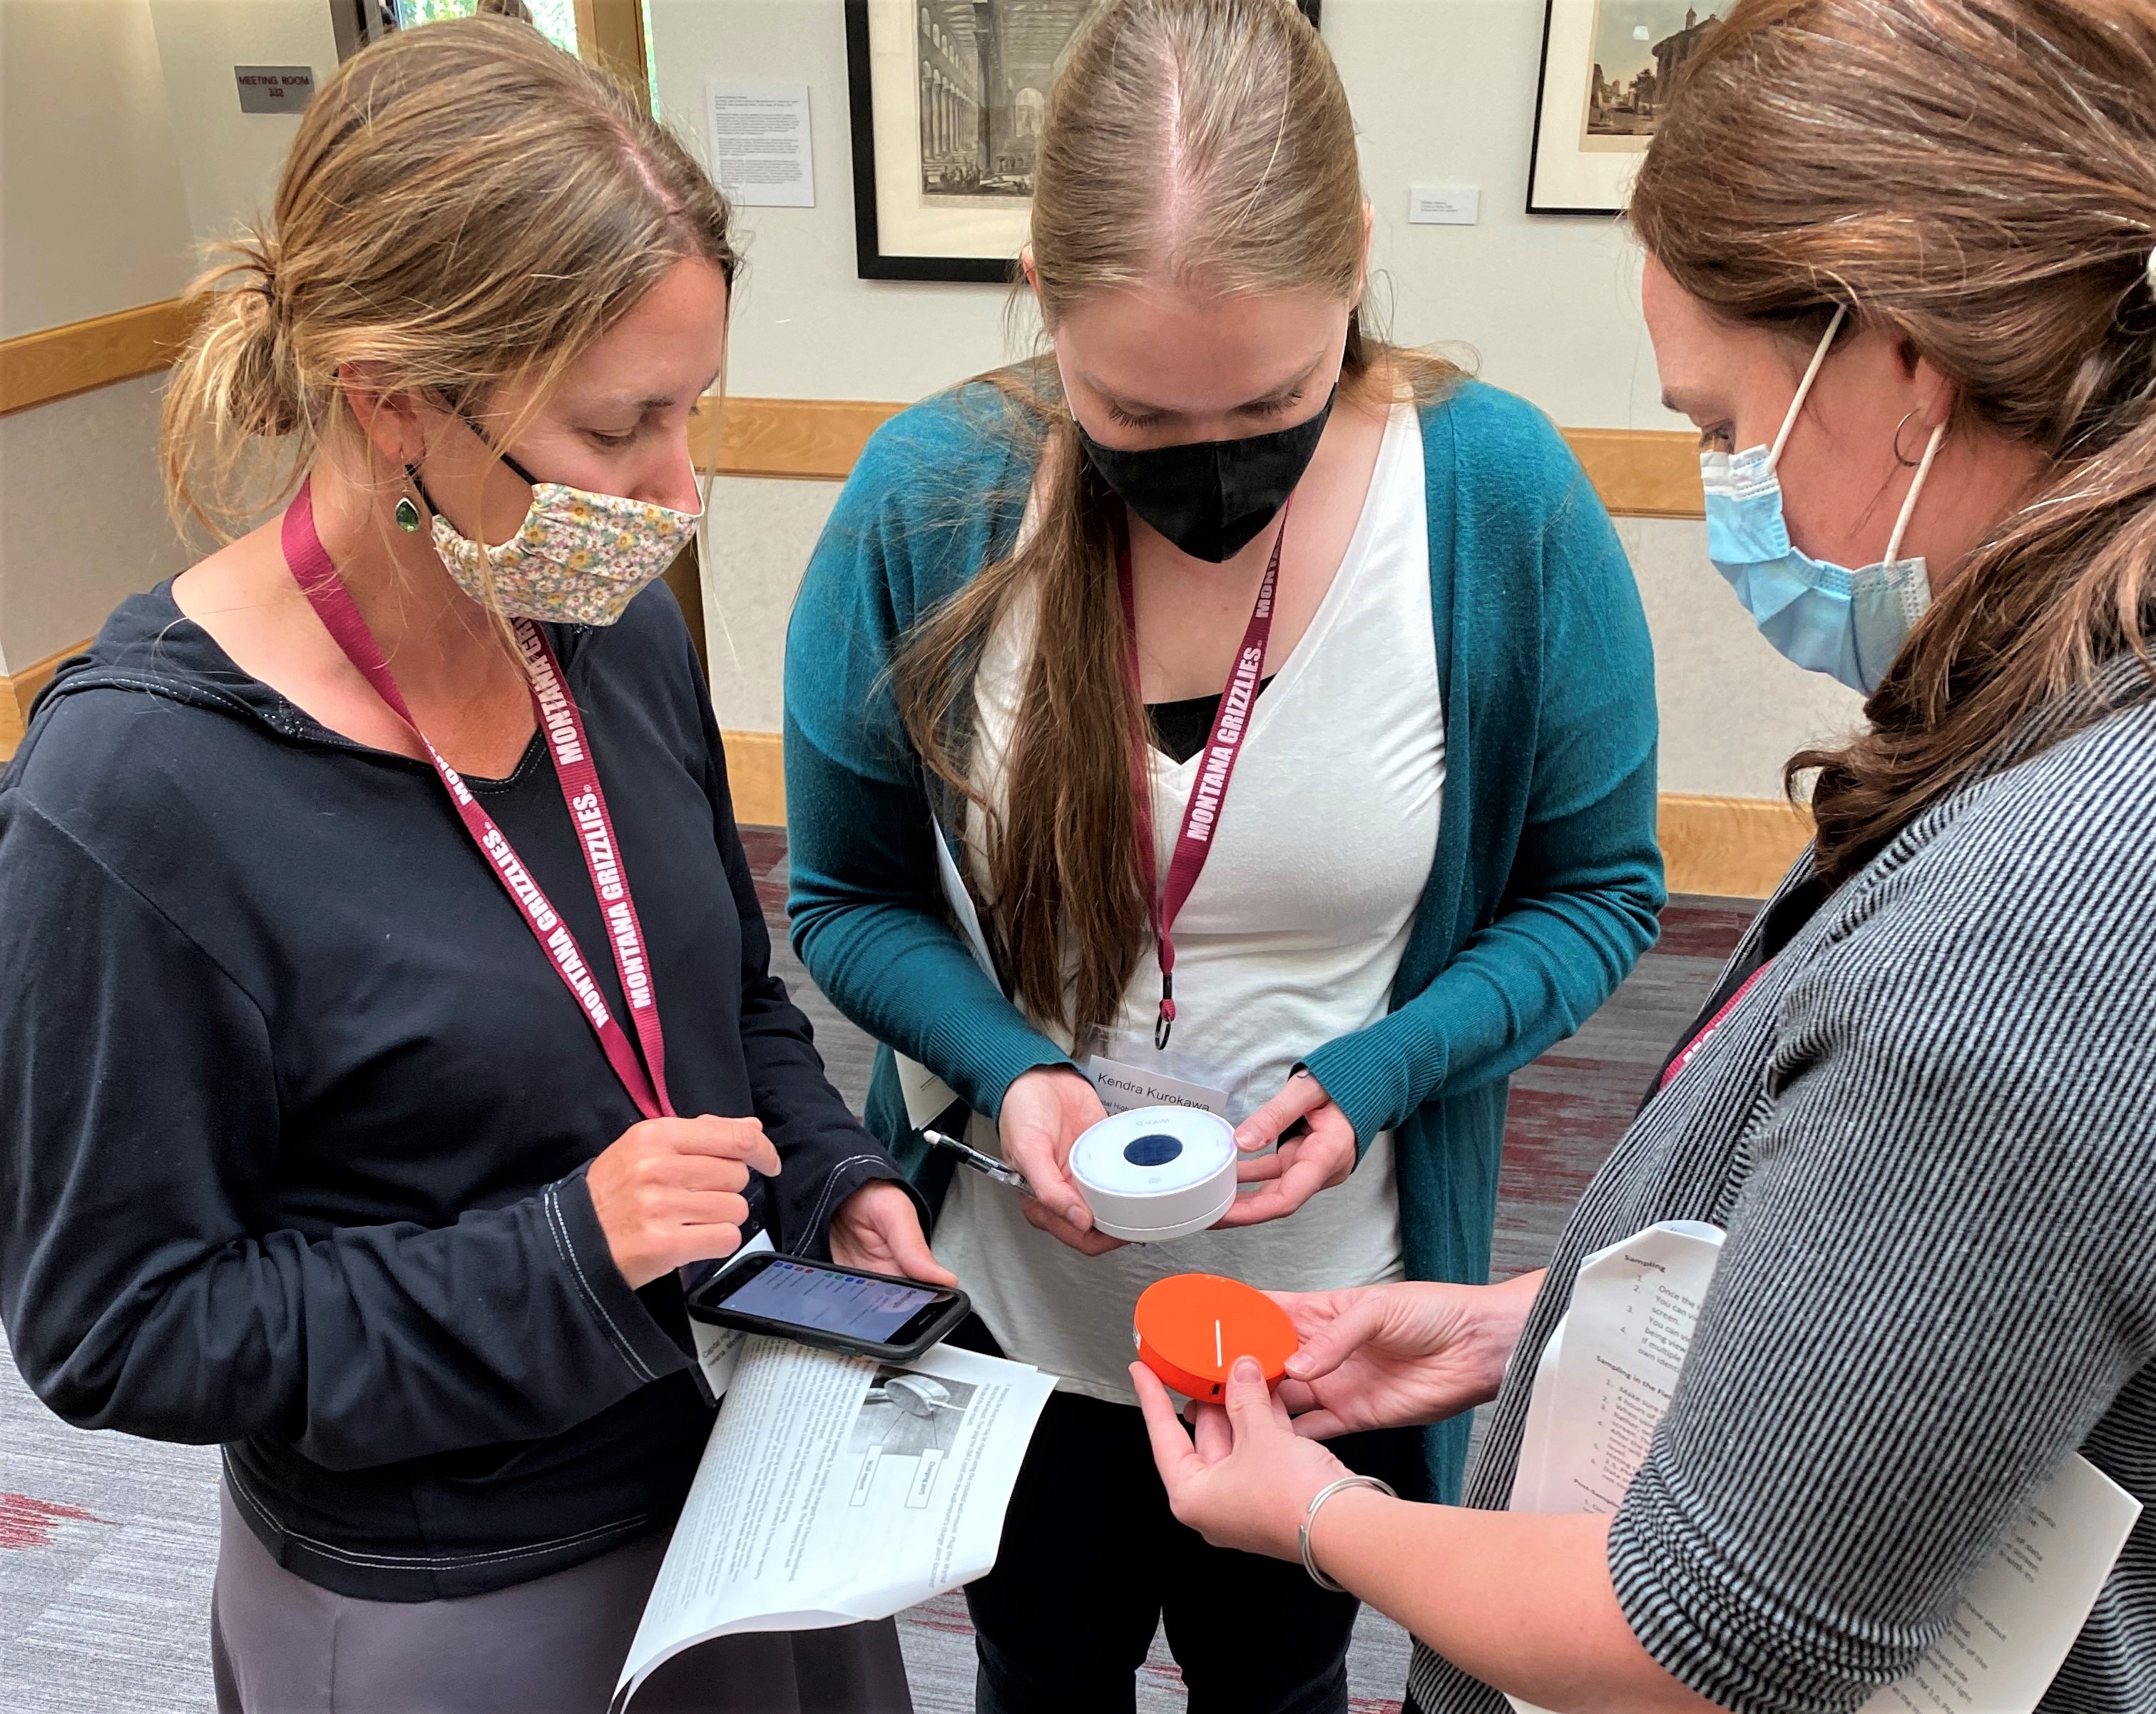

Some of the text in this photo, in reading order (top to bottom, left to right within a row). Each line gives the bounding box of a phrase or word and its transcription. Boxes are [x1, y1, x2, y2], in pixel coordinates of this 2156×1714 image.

[239, 76, 310, 85] MEETING ROOM
[1187, 746, 1234, 842] MONTANA
[608, 901, 651, 1009] MONTANA
[547, 927, 610, 1029] MONTANA
[1098, 1072, 1210, 1112] Kendra Kurokawa
[1625, 1255, 1666, 1272] Sampling
[1656, 1295, 1671, 1308] You
[1672, 1305, 1687, 1316] can
[1659, 1285, 1680, 1300] Once
[1682, 1297, 1695, 1308] the
[1645, 1327, 1667, 1345] being
[1649, 1316, 1664, 1329] You
[1665, 1327, 1679, 1337] can
[1596, 1355, 1631, 1380] Sampling
[1642, 1381, 1657, 1392] the
